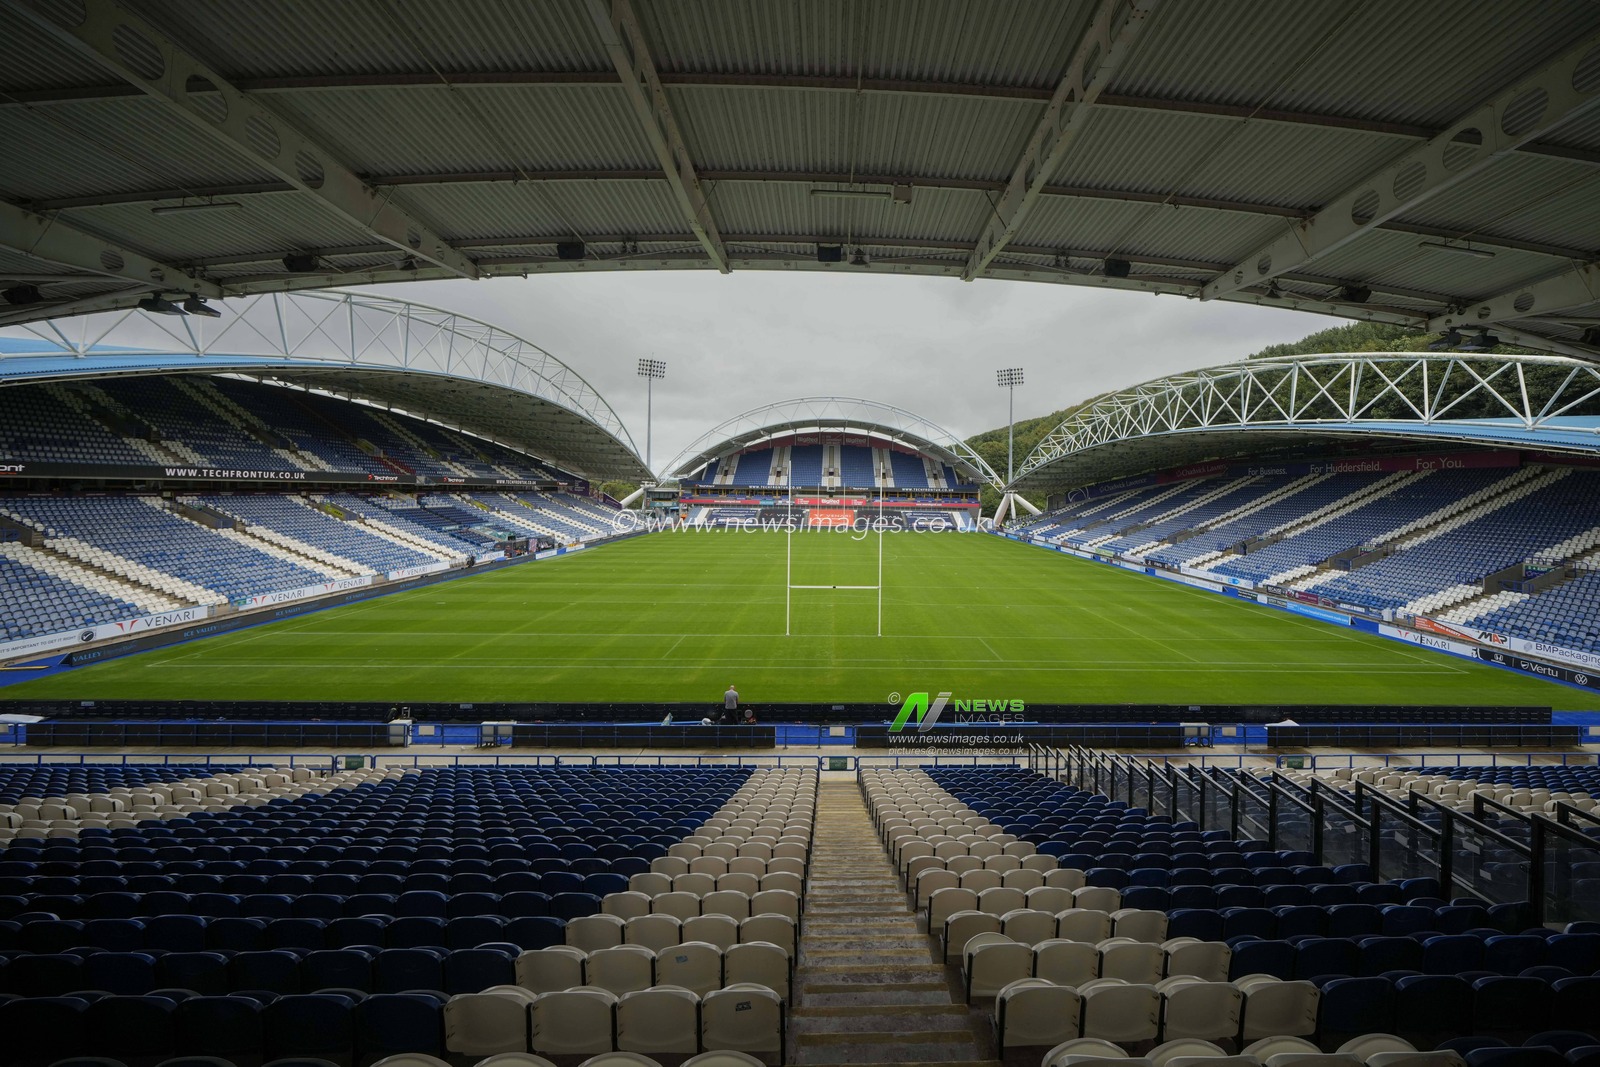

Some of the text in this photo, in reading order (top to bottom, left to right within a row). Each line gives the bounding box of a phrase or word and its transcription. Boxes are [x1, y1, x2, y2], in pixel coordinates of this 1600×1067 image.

[1310, 460, 1382, 474] For Huddersfield.
[1416, 457, 1465, 469] For You.
[165, 468, 306, 480] WWW.TECHFRONTUK.CO.UK
[1248, 467, 1287, 476] For Business.
[407, 567, 428, 576] VENARI
[338, 579, 365, 589] VENARI
[271, 589, 305, 602] VENARI
[144, 610, 195, 627] VENARI
[184, 625, 217, 638] ICE VALLEY
[11, 643, 39, 652] IMPORTANT
[1413, 634, 1450, 650] VENARI
[72, 651, 101, 662] VALLEY
[1530, 662, 1559, 677] Vertu
